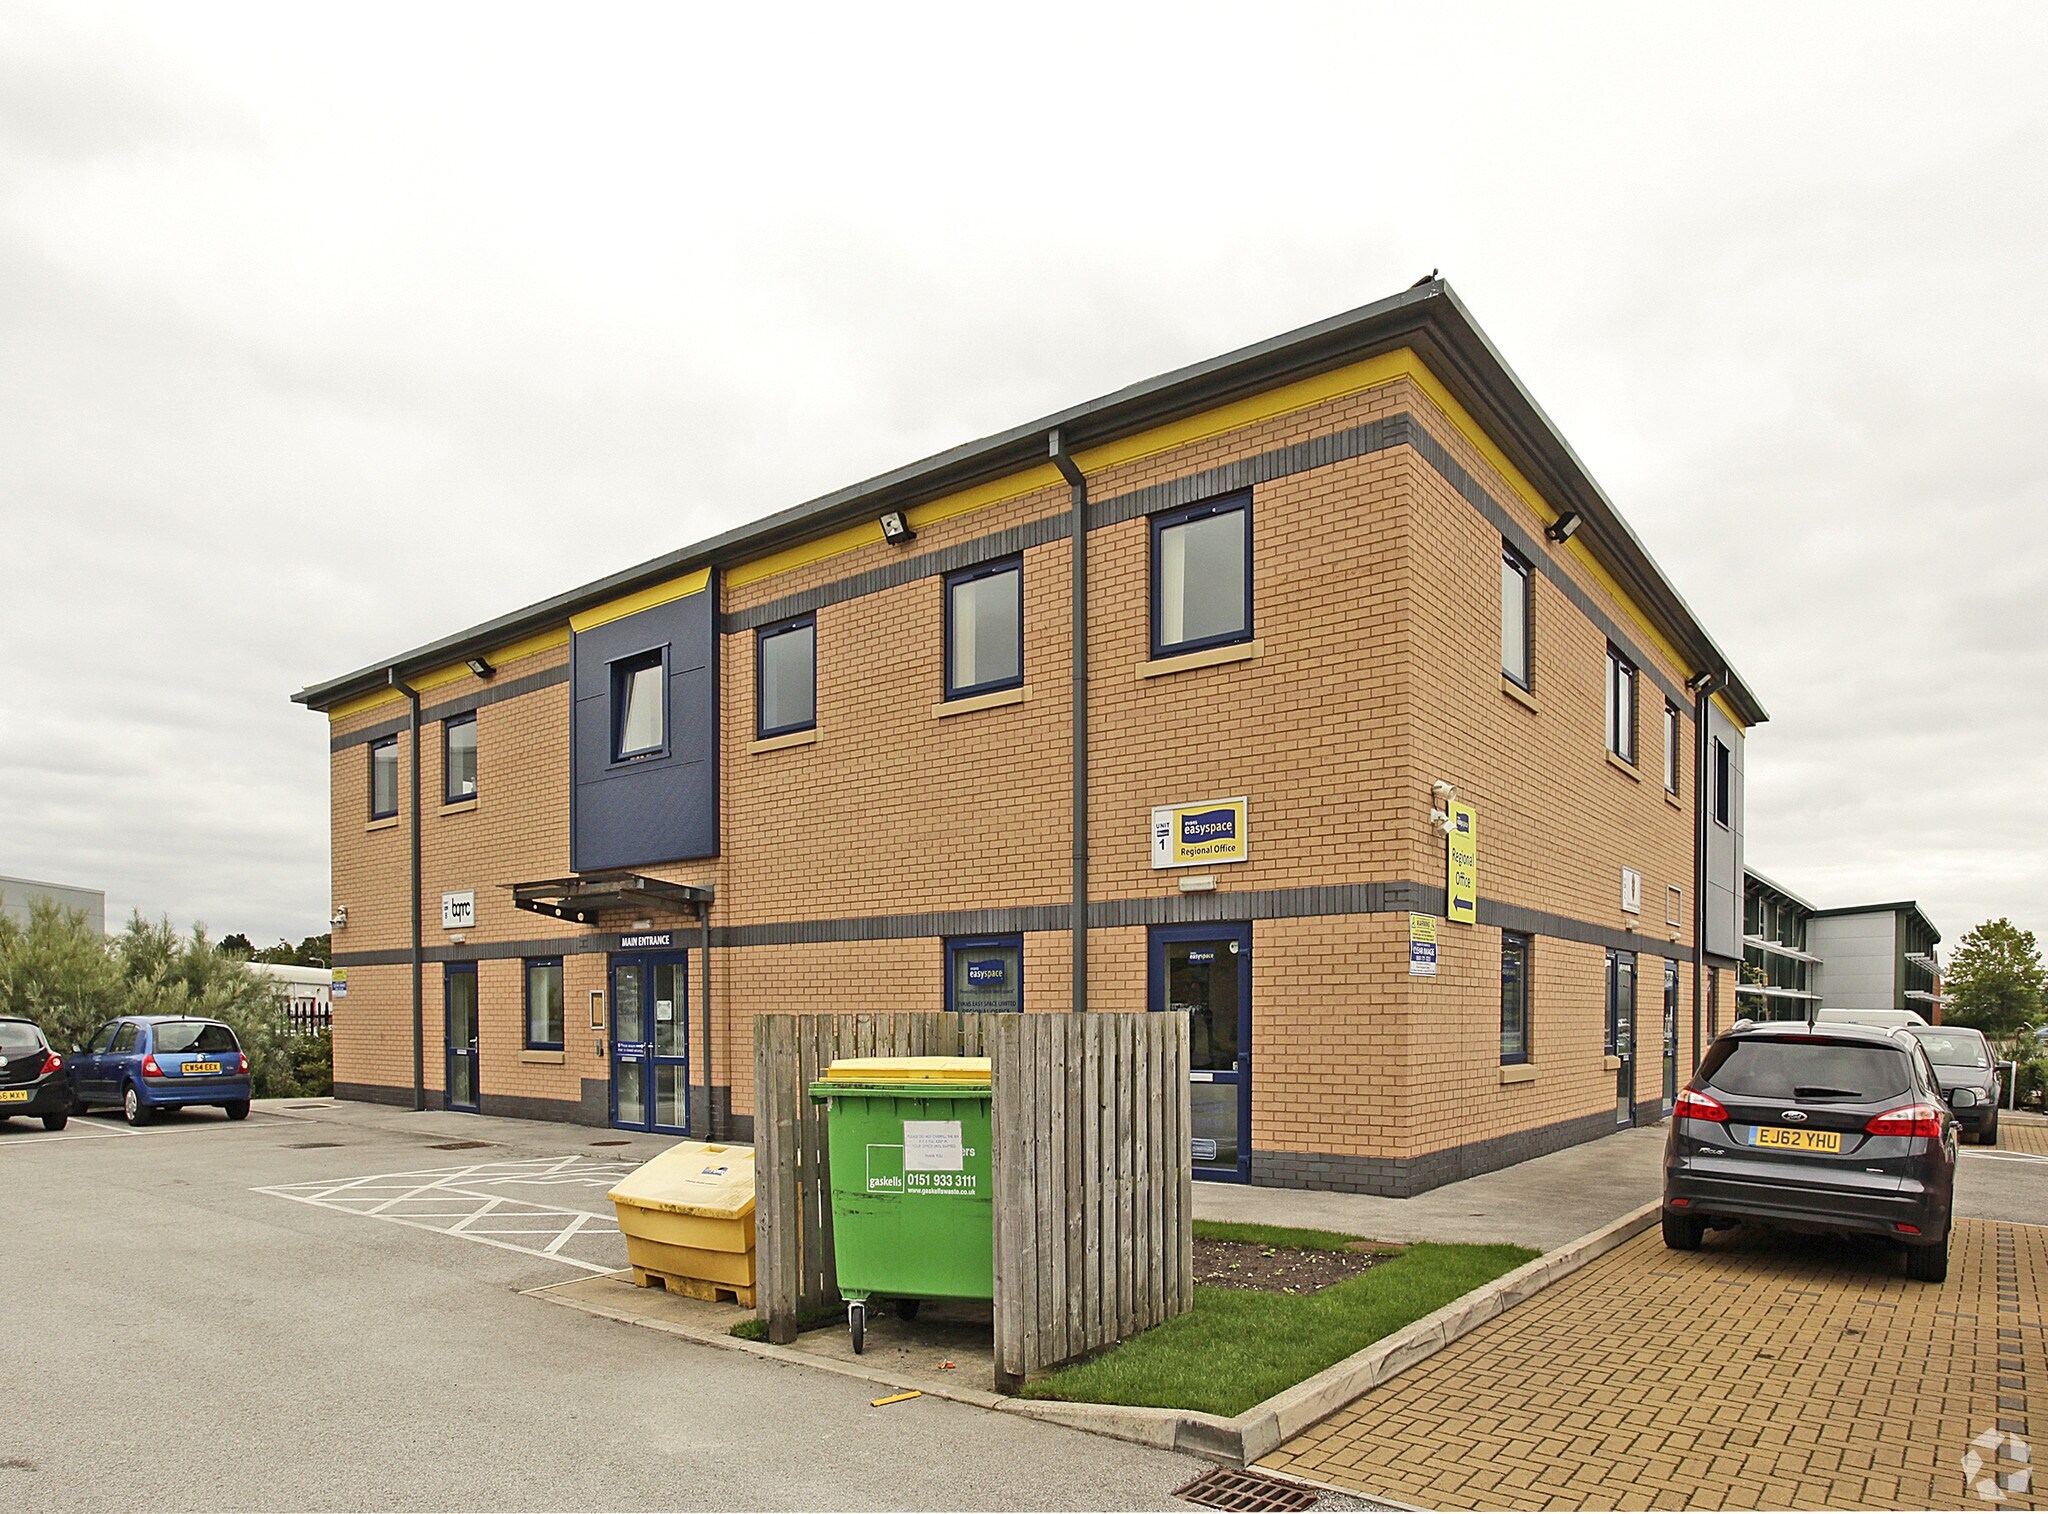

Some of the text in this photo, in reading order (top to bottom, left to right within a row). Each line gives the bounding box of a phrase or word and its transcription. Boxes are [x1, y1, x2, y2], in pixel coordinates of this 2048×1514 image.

[1184, 821, 1233, 835] easyspace
[1159, 838, 1165, 850] 1
[1180, 843, 1236, 858] Regional Office
[1452, 847, 1475, 868] Regional
[1455, 871, 1471, 889] Office
[621, 934, 670, 947] MAIN ENTRANCE
[969, 969, 1003, 980] easyspace
[204, 1063, 218, 1071] EEX
[1759, 1128, 1837, 1149] EJ62 YHU
[869, 1175, 902, 1189] gaskells
[907, 1173, 977, 1187] 0151 933 3111
[907, 1187, 976, 1196] www.gaskellswaste.co.uk
